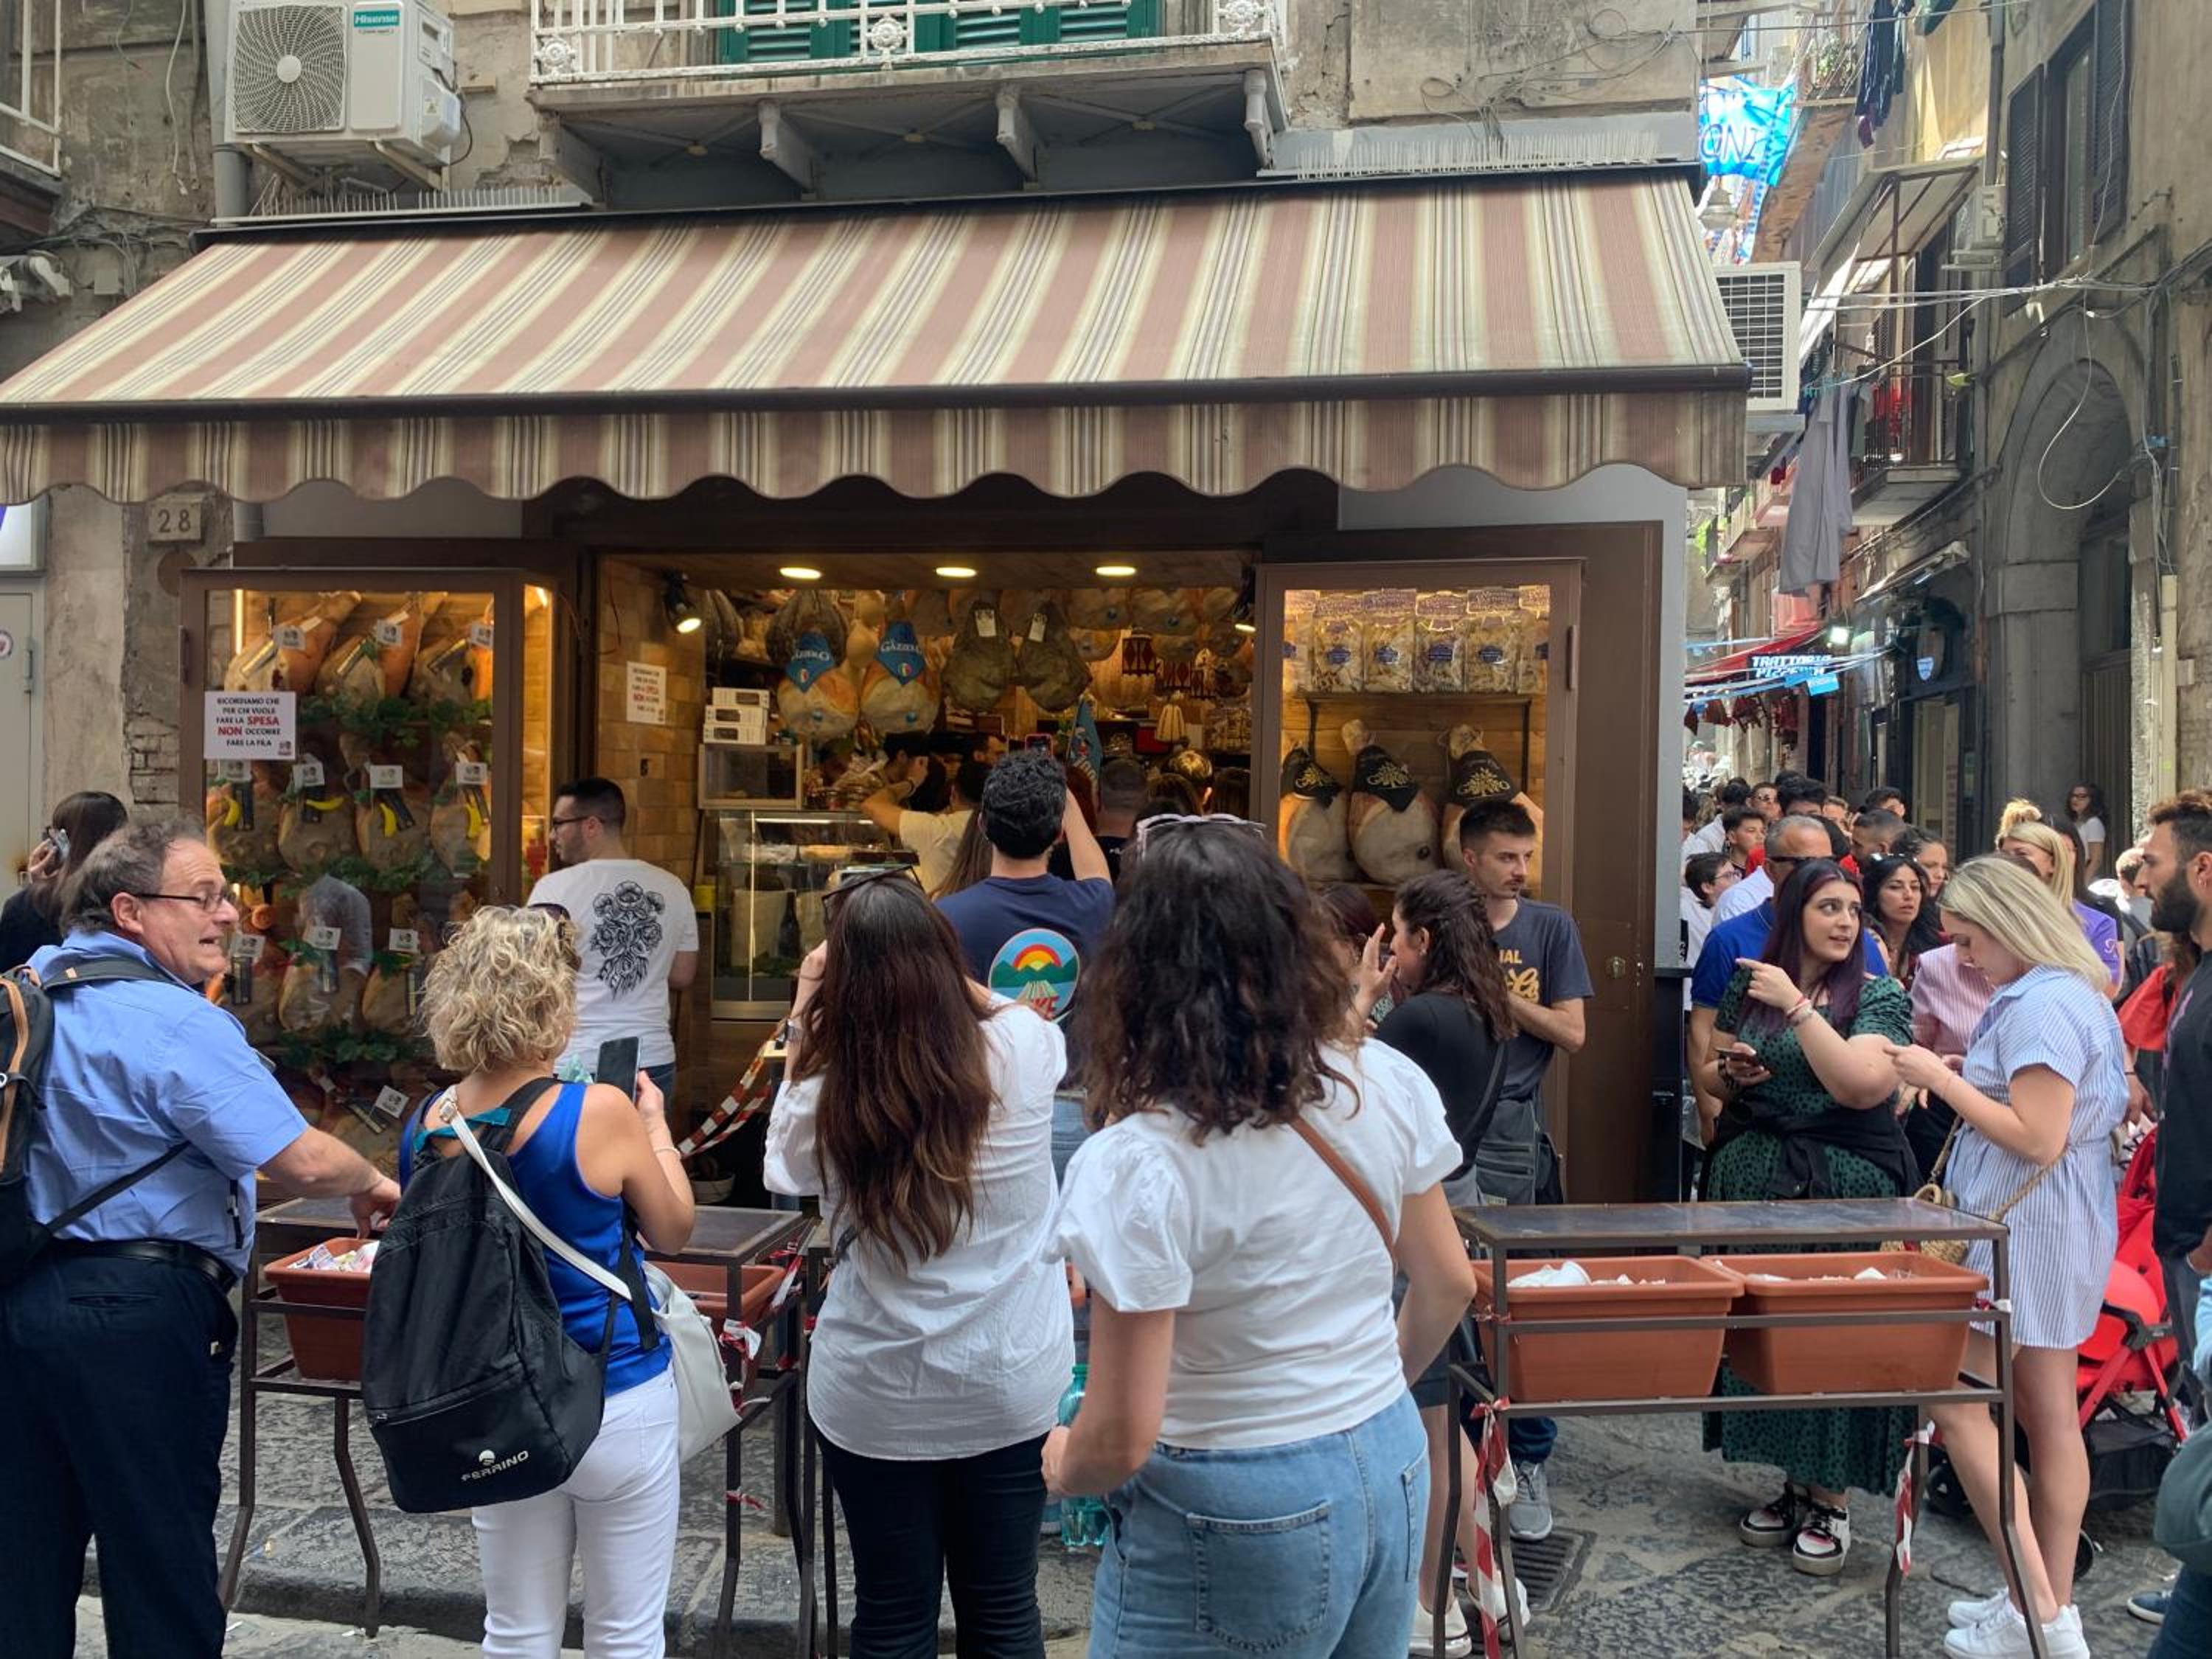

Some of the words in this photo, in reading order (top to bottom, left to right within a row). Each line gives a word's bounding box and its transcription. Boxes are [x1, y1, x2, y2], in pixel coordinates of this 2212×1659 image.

[355, 14, 398, 24] Hisense
[158, 508, 191, 533] 28
[1752, 654, 1832, 667] TRATTORIA
[247, 716, 279, 726] SPESA
[218, 726, 243, 735] NON
[461, 1450, 529, 1481] FERRINO
